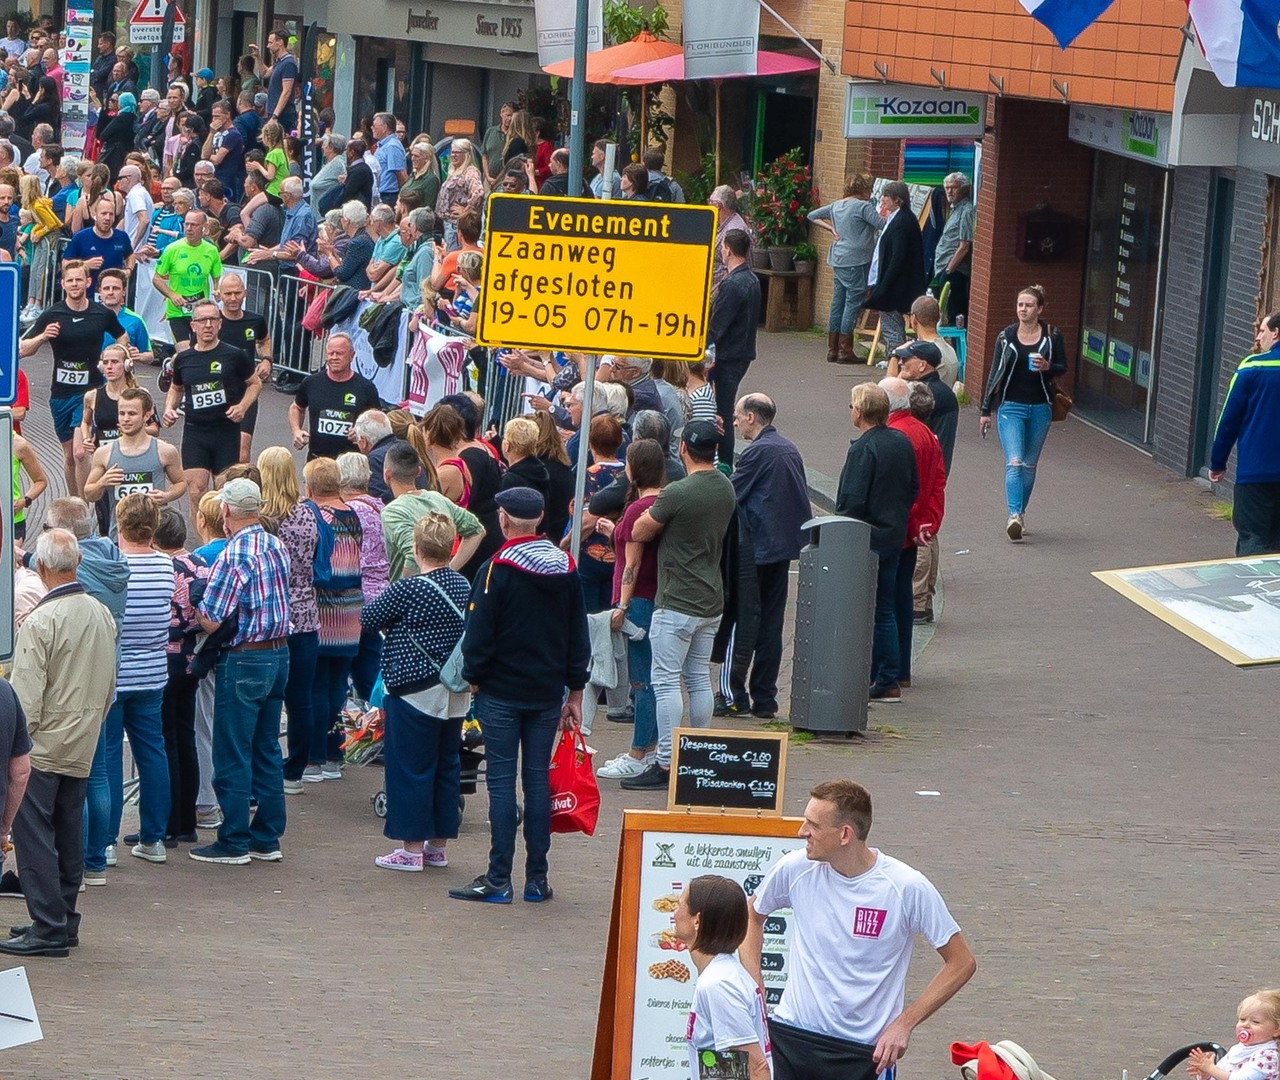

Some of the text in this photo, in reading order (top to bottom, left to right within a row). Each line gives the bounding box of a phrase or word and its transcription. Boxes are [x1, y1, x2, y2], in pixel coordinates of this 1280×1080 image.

[539, 29, 596, 40] FLORIBUUS
[686, 39, 752, 50] FLORIBUNDUS
[883, 97, 967, 115] Kozaan
[528, 205, 671, 238] Evenement
[498, 235, 616, 272] Zaanweg
[494, 269, 634, 301] afgesloten
[491, 301, 696, 338] 19-05 07h-19h
[60, 370, 85, 383] 787
[195, 393, 223, 408] 958
[325, 409, 350, 420] RUNX
[319, 419, 350, 435] 1073
[684, 843, 772, 862] de lekkerste smullerij
[687, 856, 700, 868] uit
[702, 857, 713, 868] de
[714, 859, 762, 872] zaanstreek
[858, 911, 879, 923] BIZZ
[857, 922, 878, 935] NIZZ
